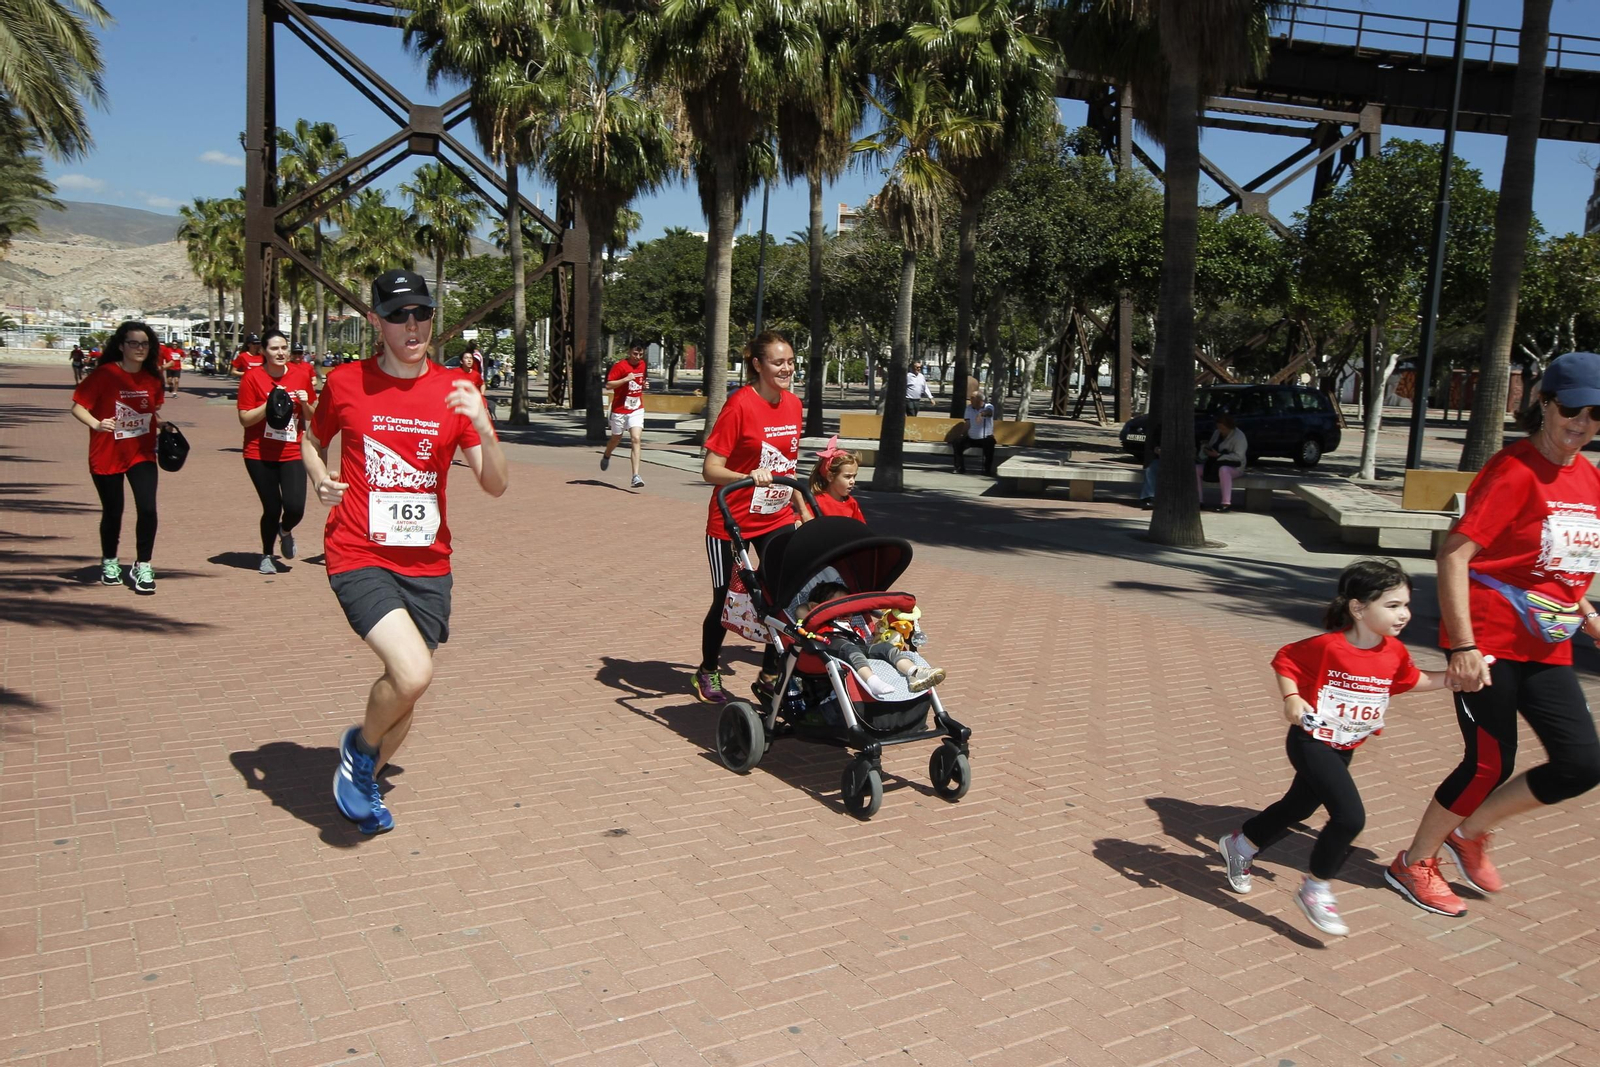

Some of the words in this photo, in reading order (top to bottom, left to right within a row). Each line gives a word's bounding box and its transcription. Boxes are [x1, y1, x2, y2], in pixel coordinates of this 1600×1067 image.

[120, 418, 145, 428] 1451
[385, 416, 413, 425] Carrera
[414, 418, 440, 429] Popular
[395, 425, 439, 436] Convivencia
[388, 503, 426, 521] 163
[1327, 669, 1341, 678] XV
[1341, 672, 1371, 683] Carrera
[1328, 679, 1342, 687] por
[1343, 680, 1350, 688] la
